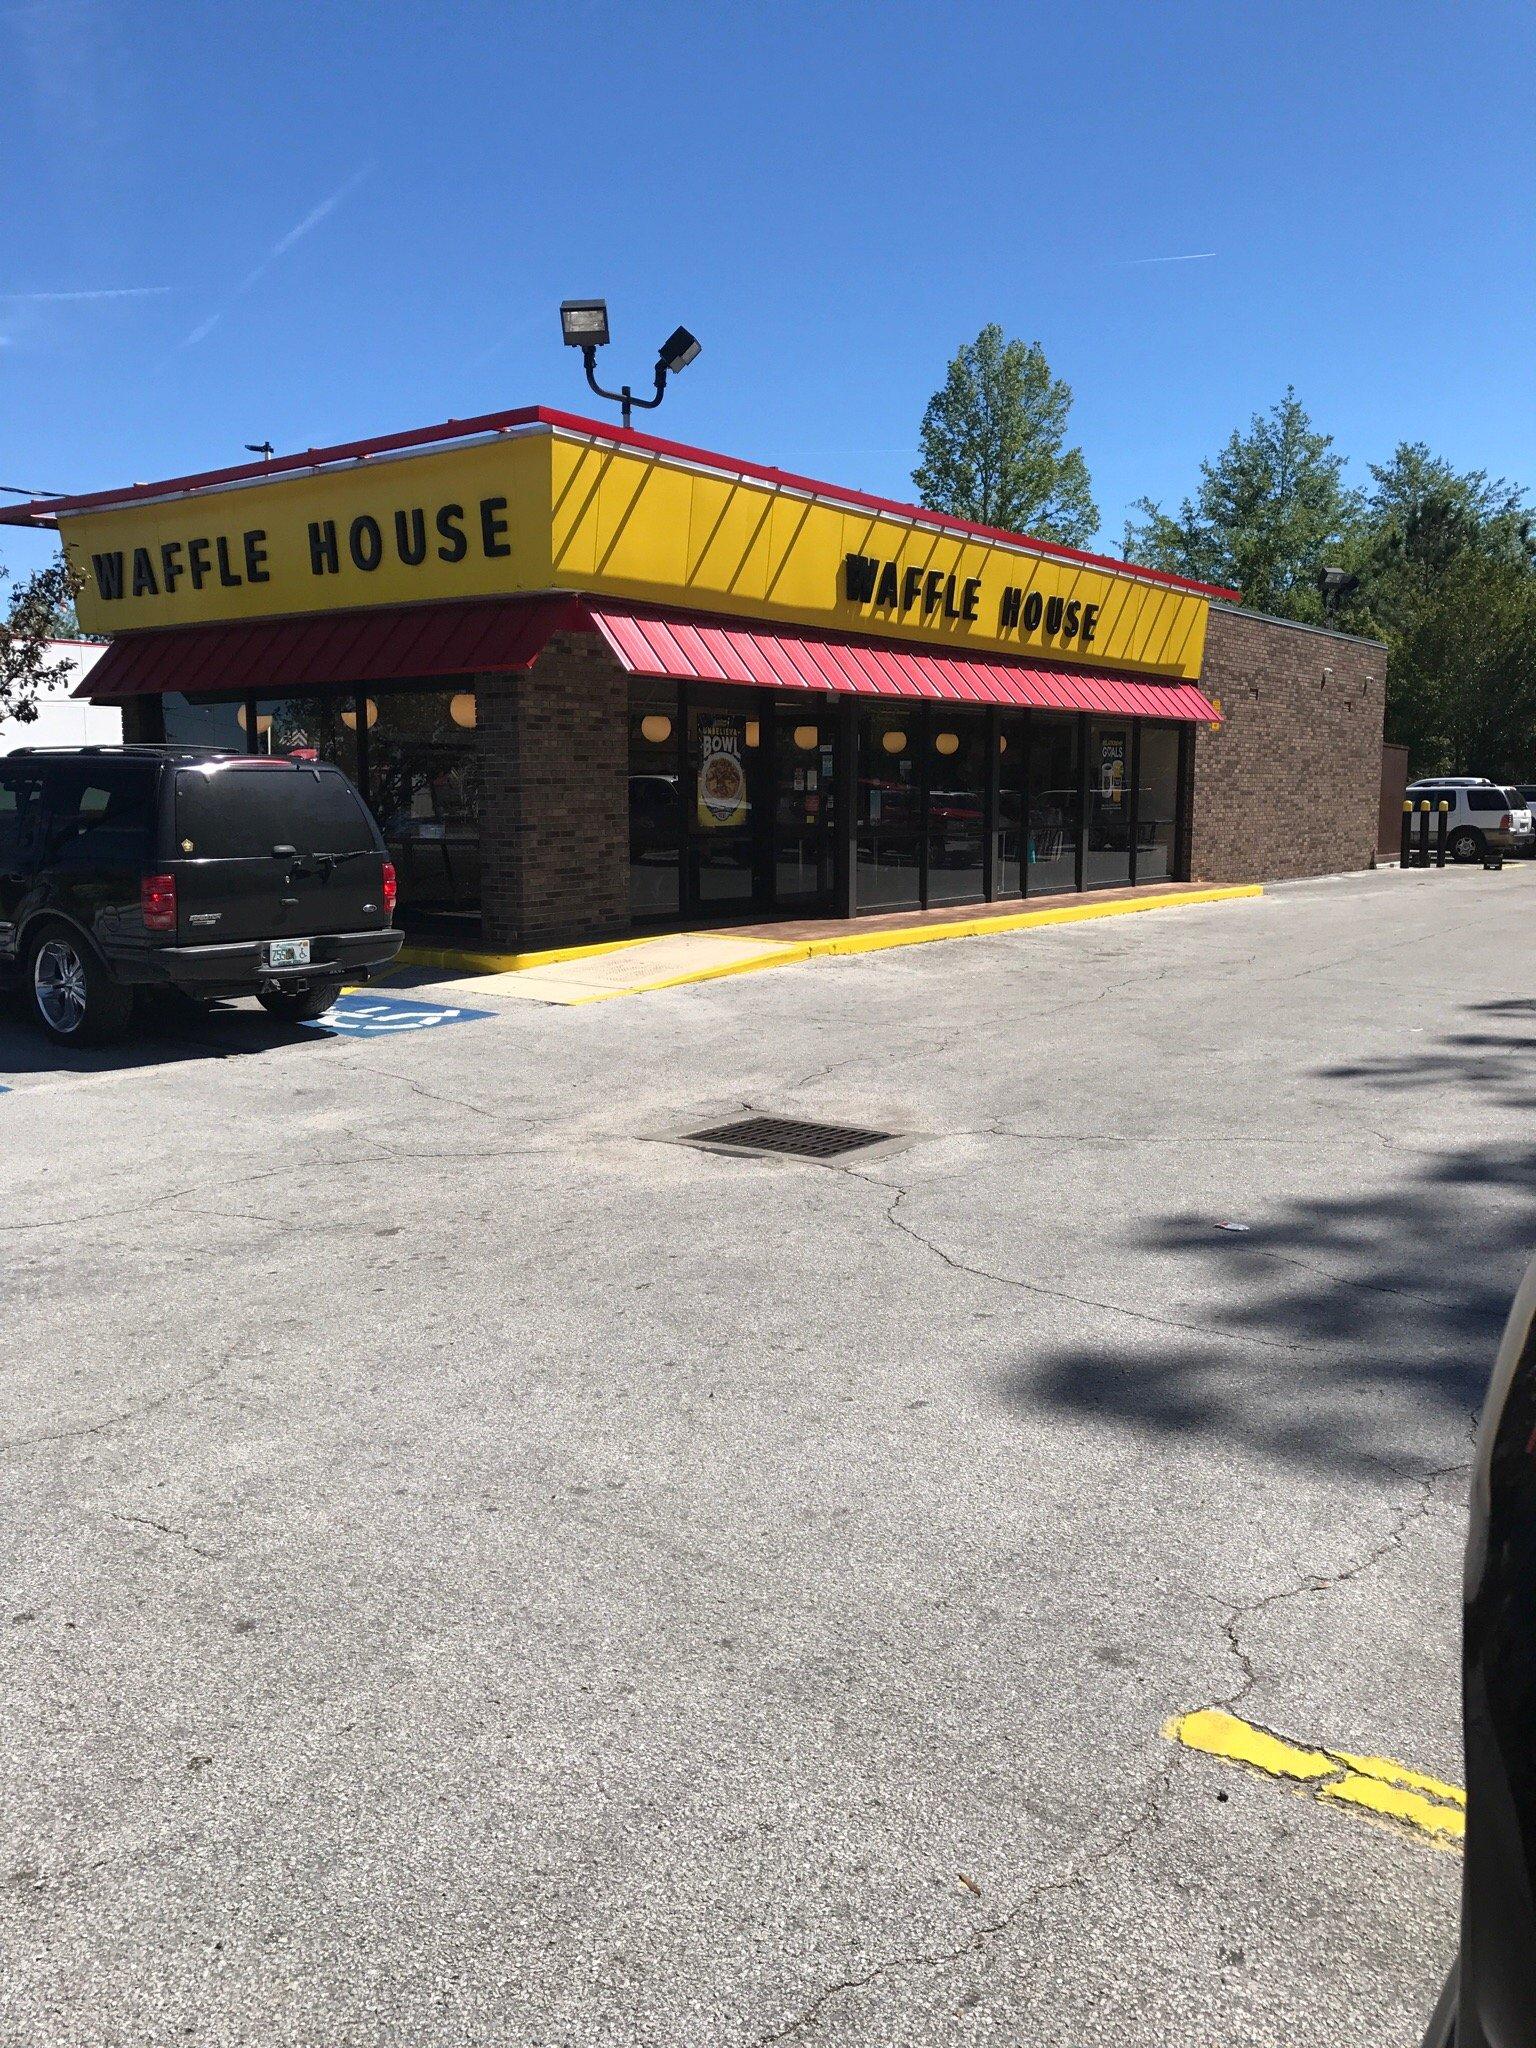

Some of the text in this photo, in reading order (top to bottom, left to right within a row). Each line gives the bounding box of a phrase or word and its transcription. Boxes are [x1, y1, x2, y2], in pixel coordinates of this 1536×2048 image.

[91, 497, 512, 601] WAFFLE HOUSE
[845, 552, 1100, 641] WAFFLE HOUSE
[703, 736, 741, 759] BOWL
